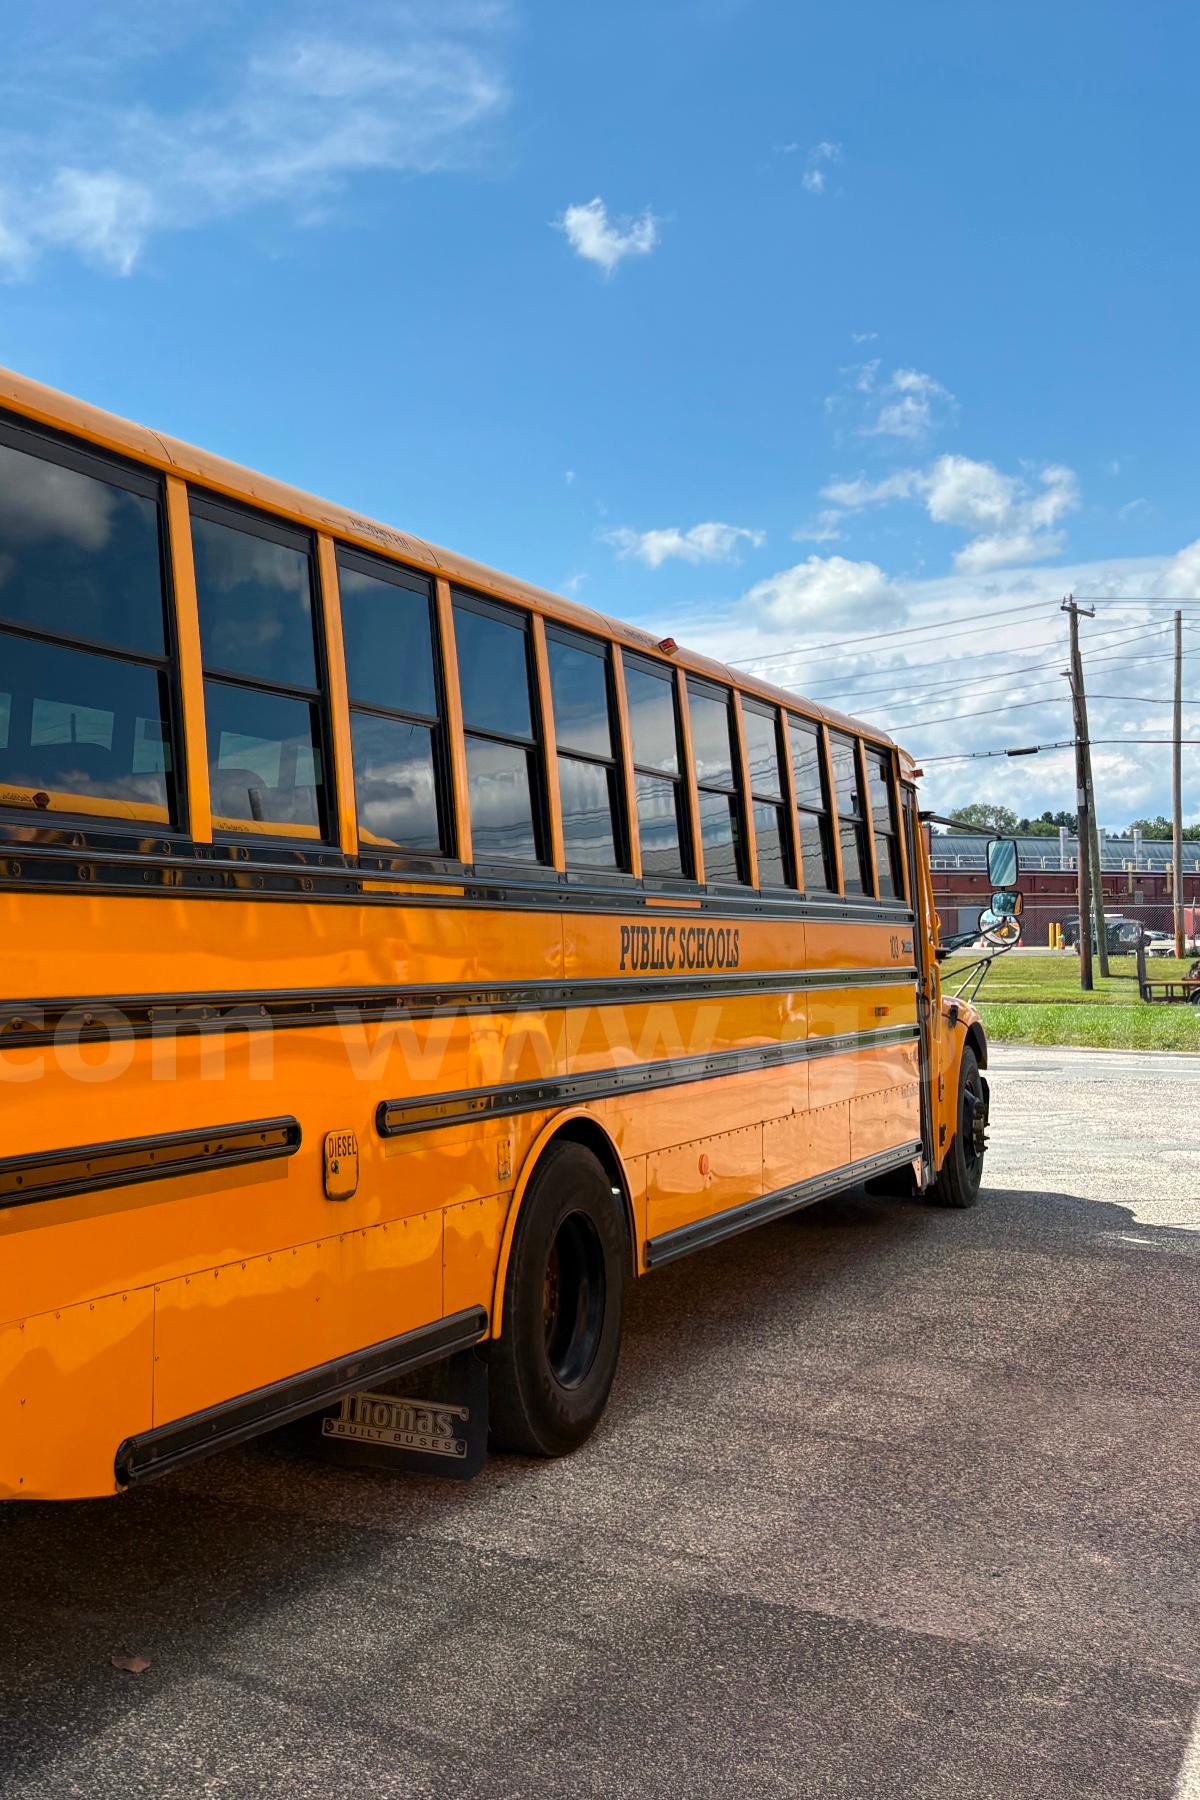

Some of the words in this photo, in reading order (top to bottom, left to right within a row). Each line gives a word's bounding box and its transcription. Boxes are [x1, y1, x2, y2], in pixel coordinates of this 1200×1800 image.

[619, 925, 676, 971] PUBLIC
[678, 926, 740, 969] SCHOOLS
[328, 1135, 358, 1159] DIESEL
[338, 1392, 468, 1438] Thomas
[337, 1424, 383, 1439] BUILT
[393, 1433, 452, 1450] BUSES
